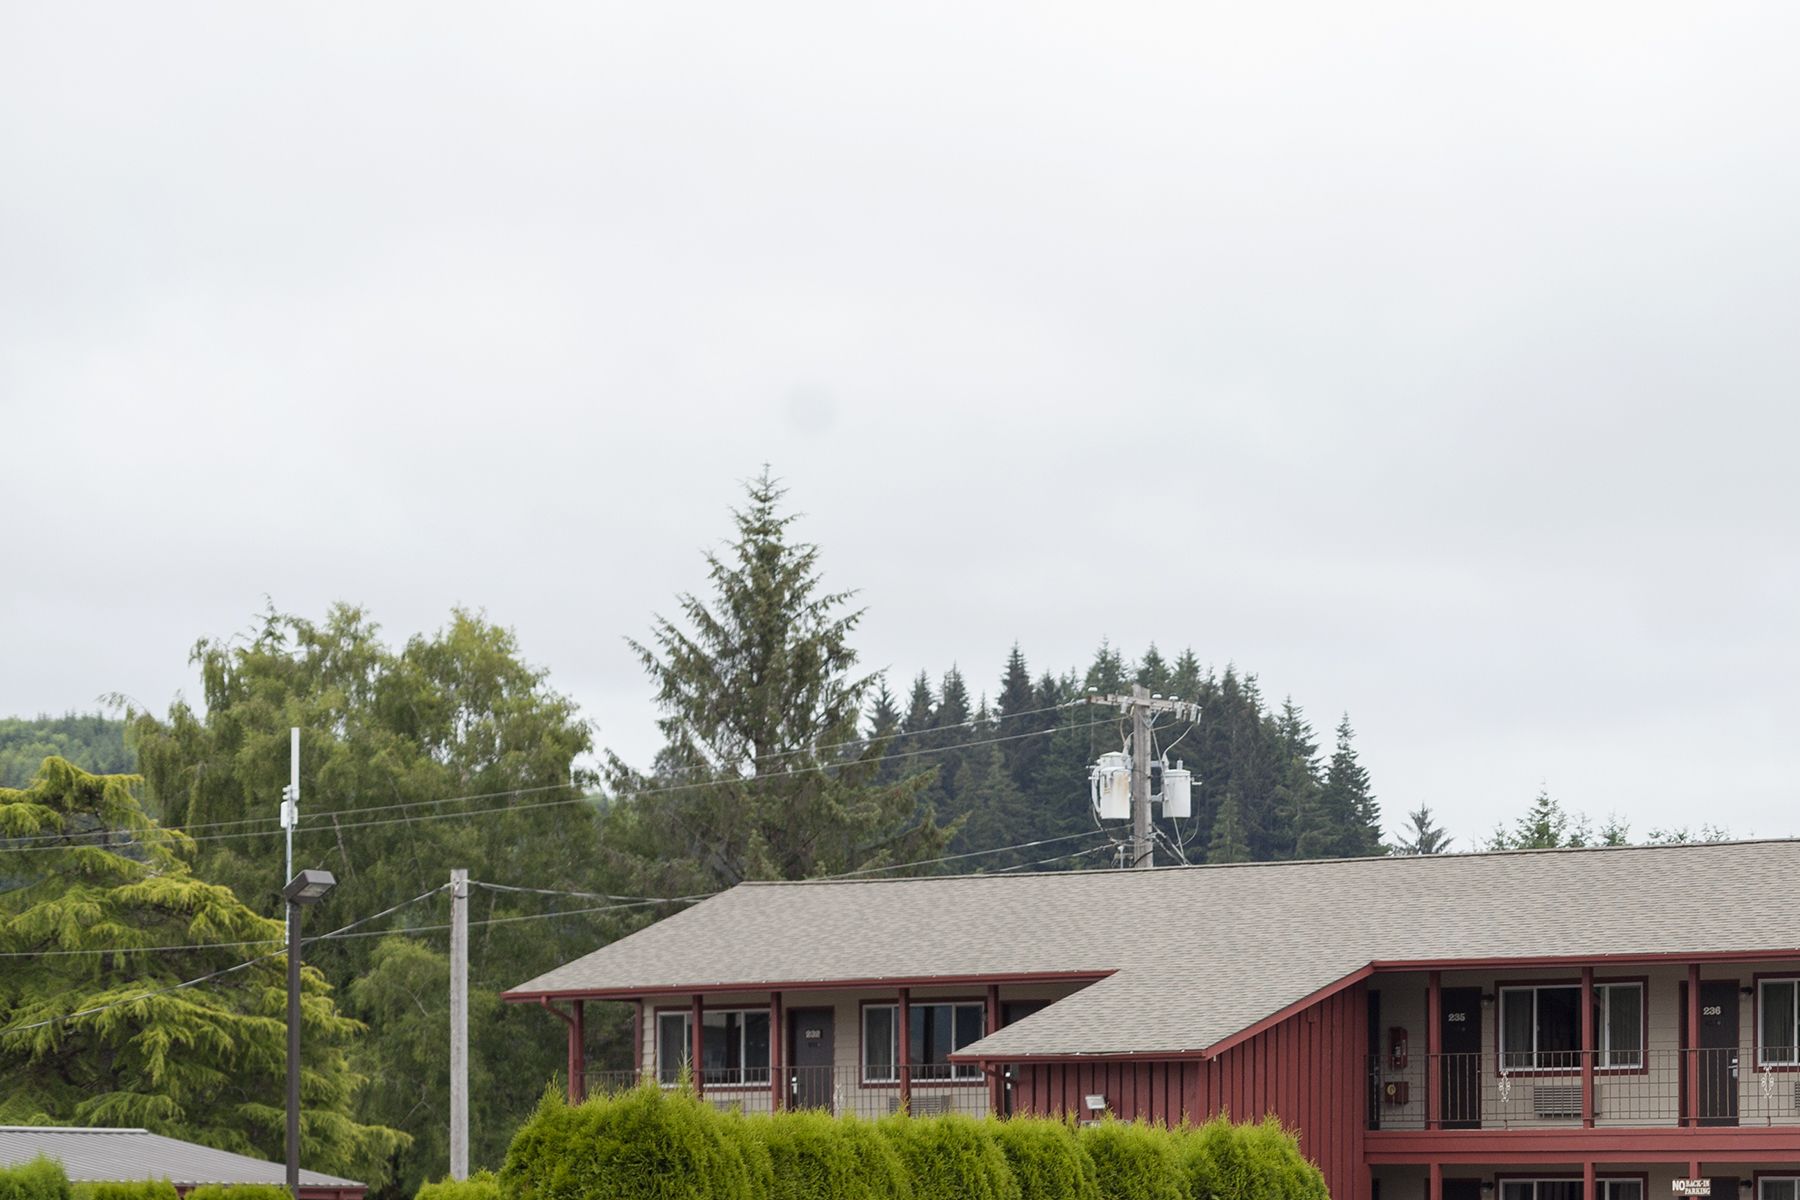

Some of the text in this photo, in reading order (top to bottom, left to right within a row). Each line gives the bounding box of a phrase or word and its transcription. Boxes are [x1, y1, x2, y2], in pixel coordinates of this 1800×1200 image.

[1703, 1006, 1721, 1015] 236
[1448, 1013, 1466, 1022] 235
[1672, 1179, 1710, 1191] NO BACK-IN
[1685, 1187, 1711, 1195] PARKING
